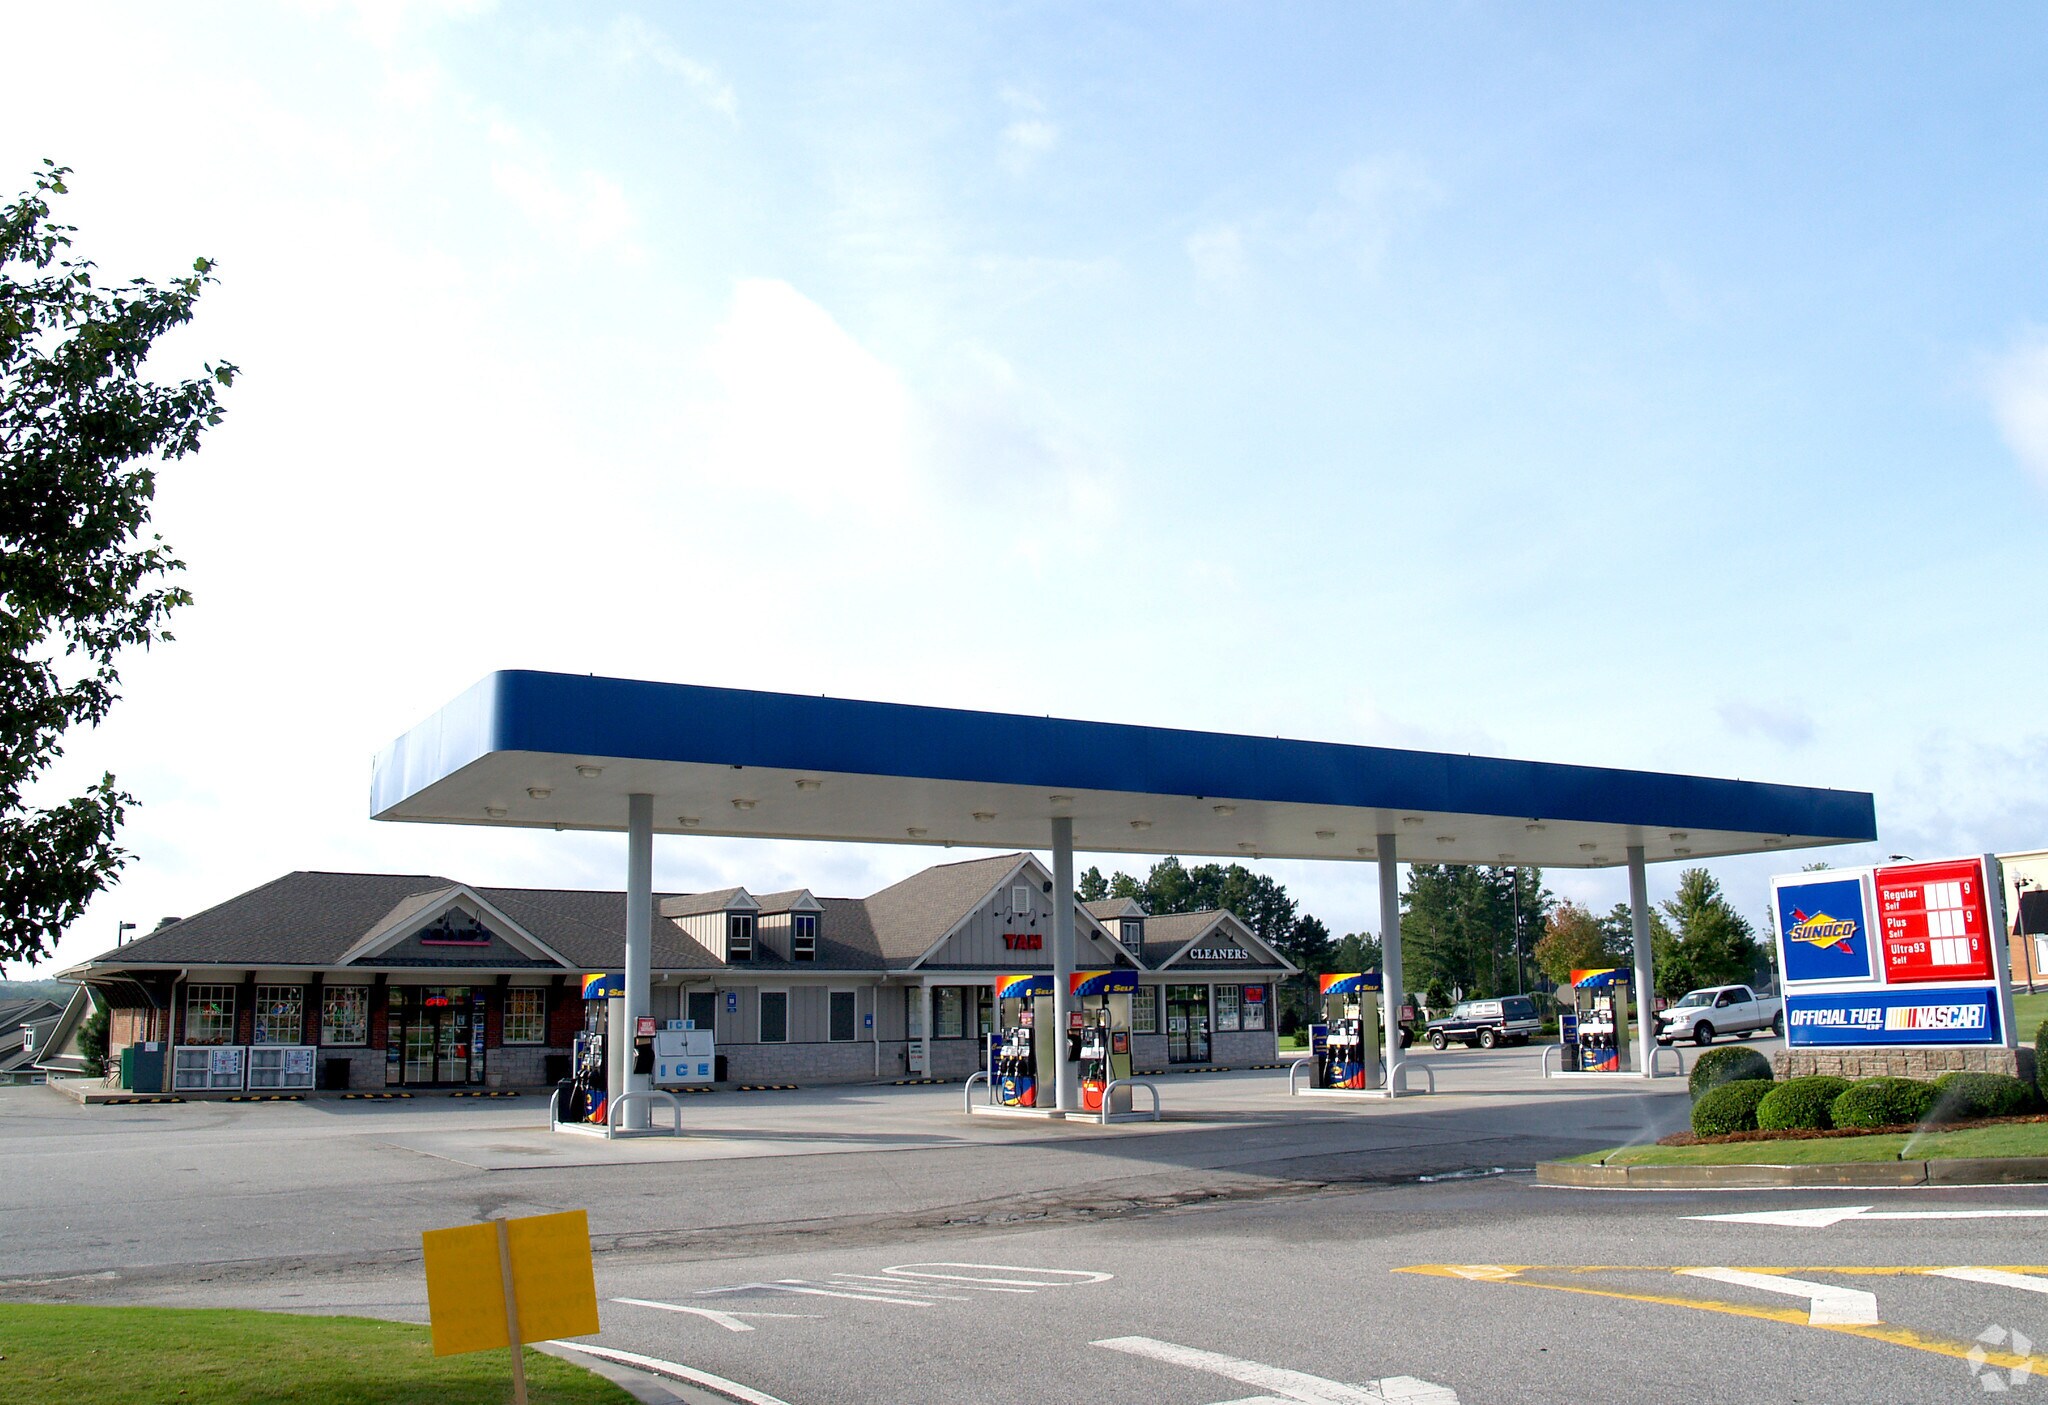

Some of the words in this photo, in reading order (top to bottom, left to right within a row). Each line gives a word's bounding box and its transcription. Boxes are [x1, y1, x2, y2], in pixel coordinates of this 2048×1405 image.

[1883, 889, 1917, 901] Regular
[1963, 882, 1971, 894] 9
[1885, 902, 1900, 910] Self
[1887, 918, 1907, 928] Plus
[1966, 910, 1973, 922] 9
[1792, 923, 1853, 939] SUNOCO
[1889, 930, 1903, 938] Self
[1002, 934, 1042, 950] TAN
[1971, 939, 1978, 951] 9
[1189, 949, 1248, 960] CLEANERS
[1892, 956, 1907, 965] Self
[1025, 988, 1032, 996] 6
[425, 998, 449, 1006] OPEN
[1790, 1009, 1848, 1026] OFFICIAL
[1848, 1007, 1883, 1024] FUEL
[1915, 1006, 1981, 1027] NASCAR
[669, 1020, 693, 1029] ICE
[660, 1063, 709, 1077] ICE
